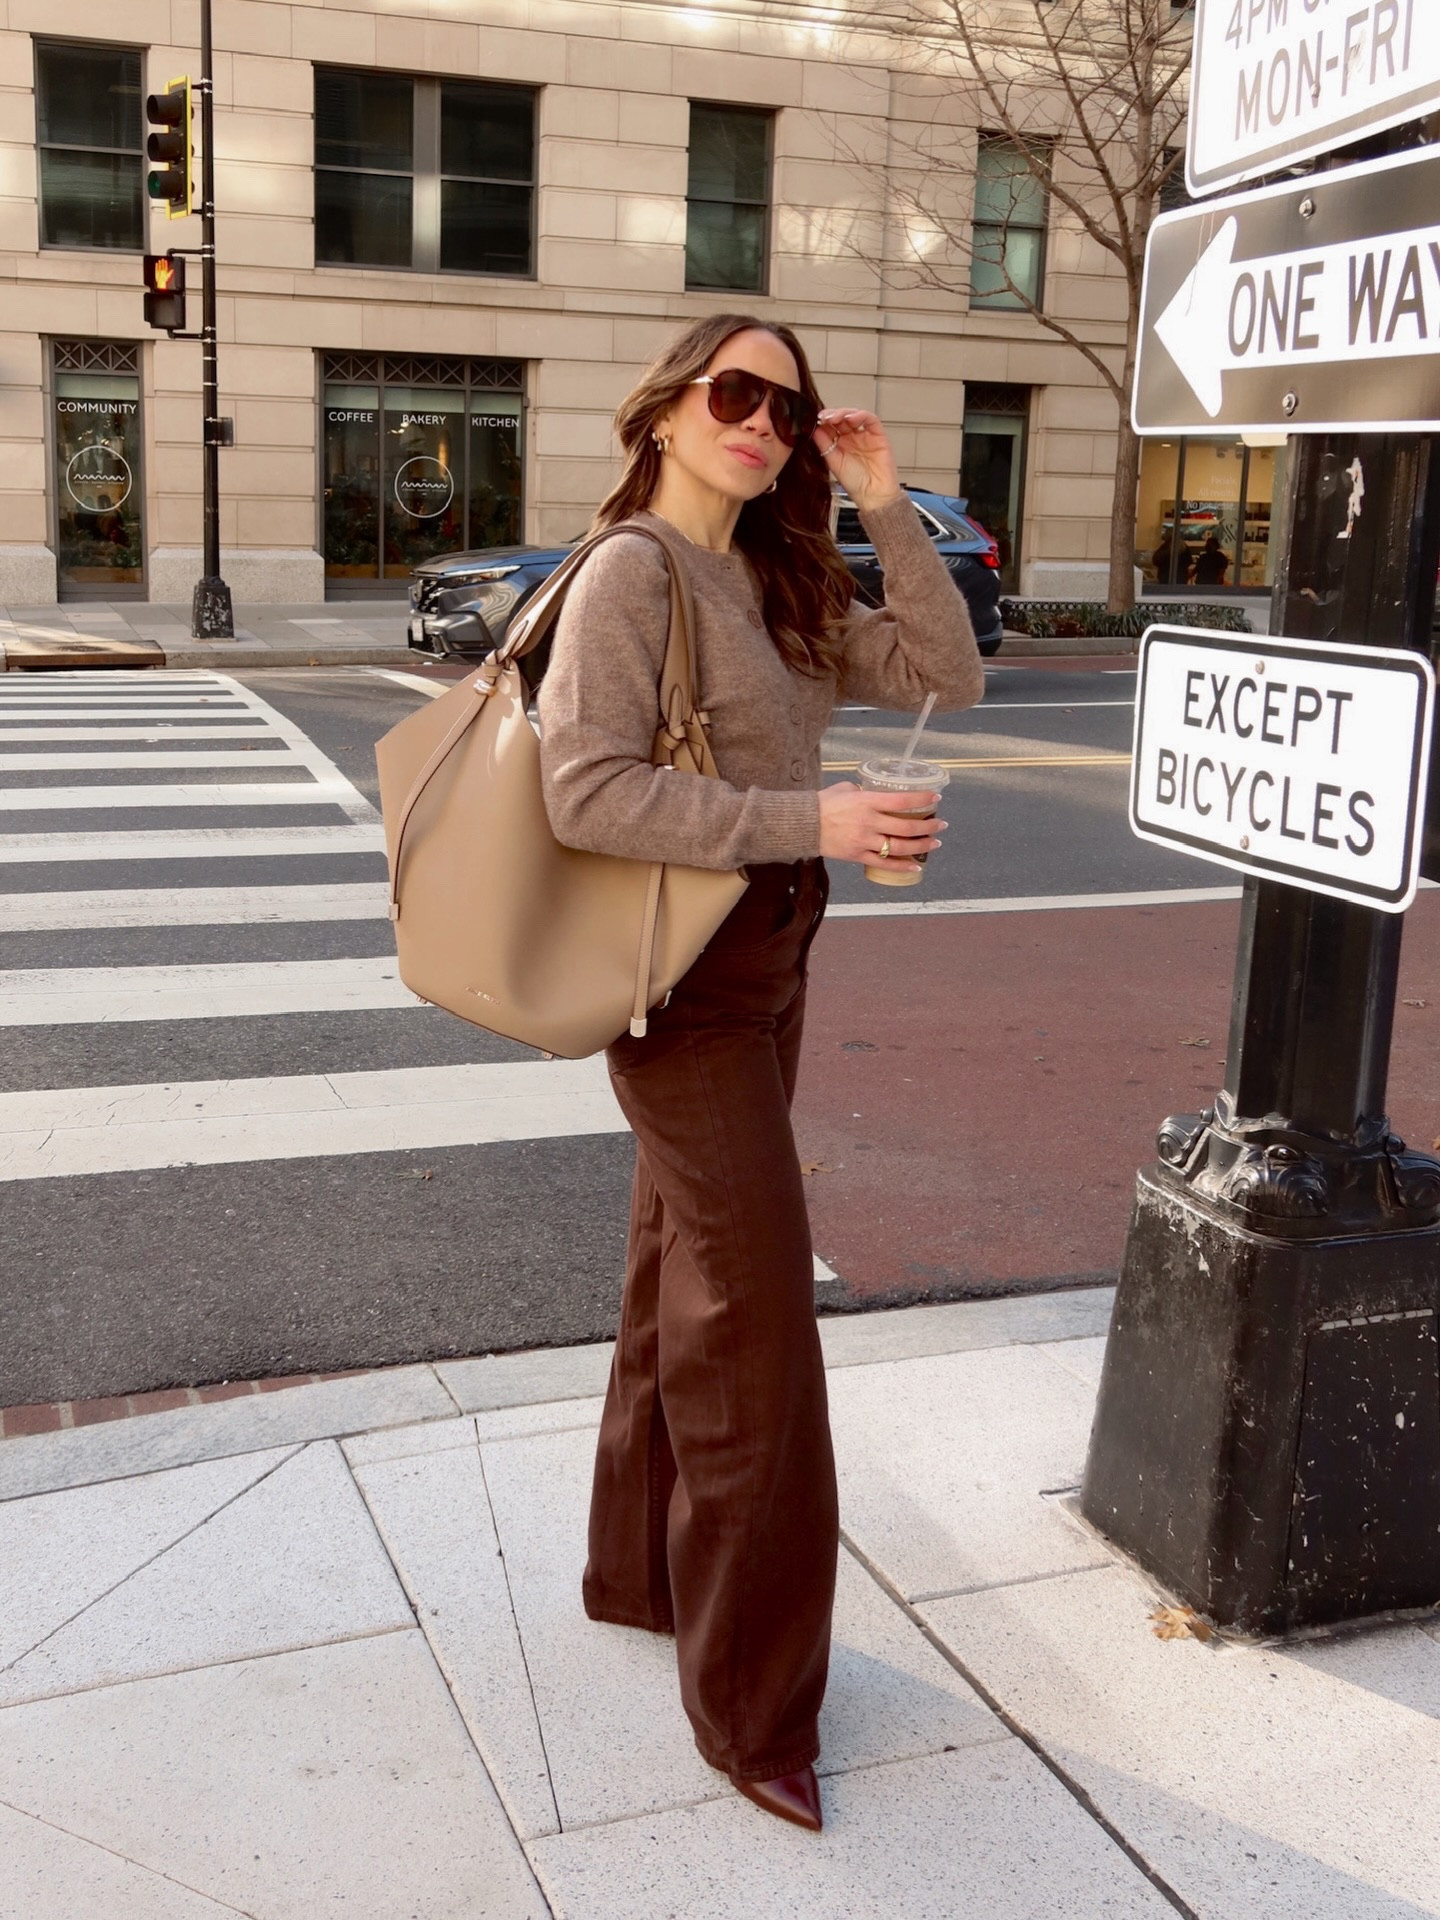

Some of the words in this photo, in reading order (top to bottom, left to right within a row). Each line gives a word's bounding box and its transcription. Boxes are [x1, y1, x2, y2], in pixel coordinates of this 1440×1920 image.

[1235, 0, 1413, 141] MON-FRI
[1228, 261, 1324, 357] ONE
[1349, 241, 1440, 345] WA
[57, 401, 137, 414] COMMUNITY
[328, 411, 374, 423] COFFEE
[402, 414, 446, 425] BAKERY
[472, 417, 520, 428] KITCHEN
[1186, 500, 1198, 509] No
[1184, 670, 1353, 755] EXCEPT
[1156, 747, 1375, 856] BICYCLES
